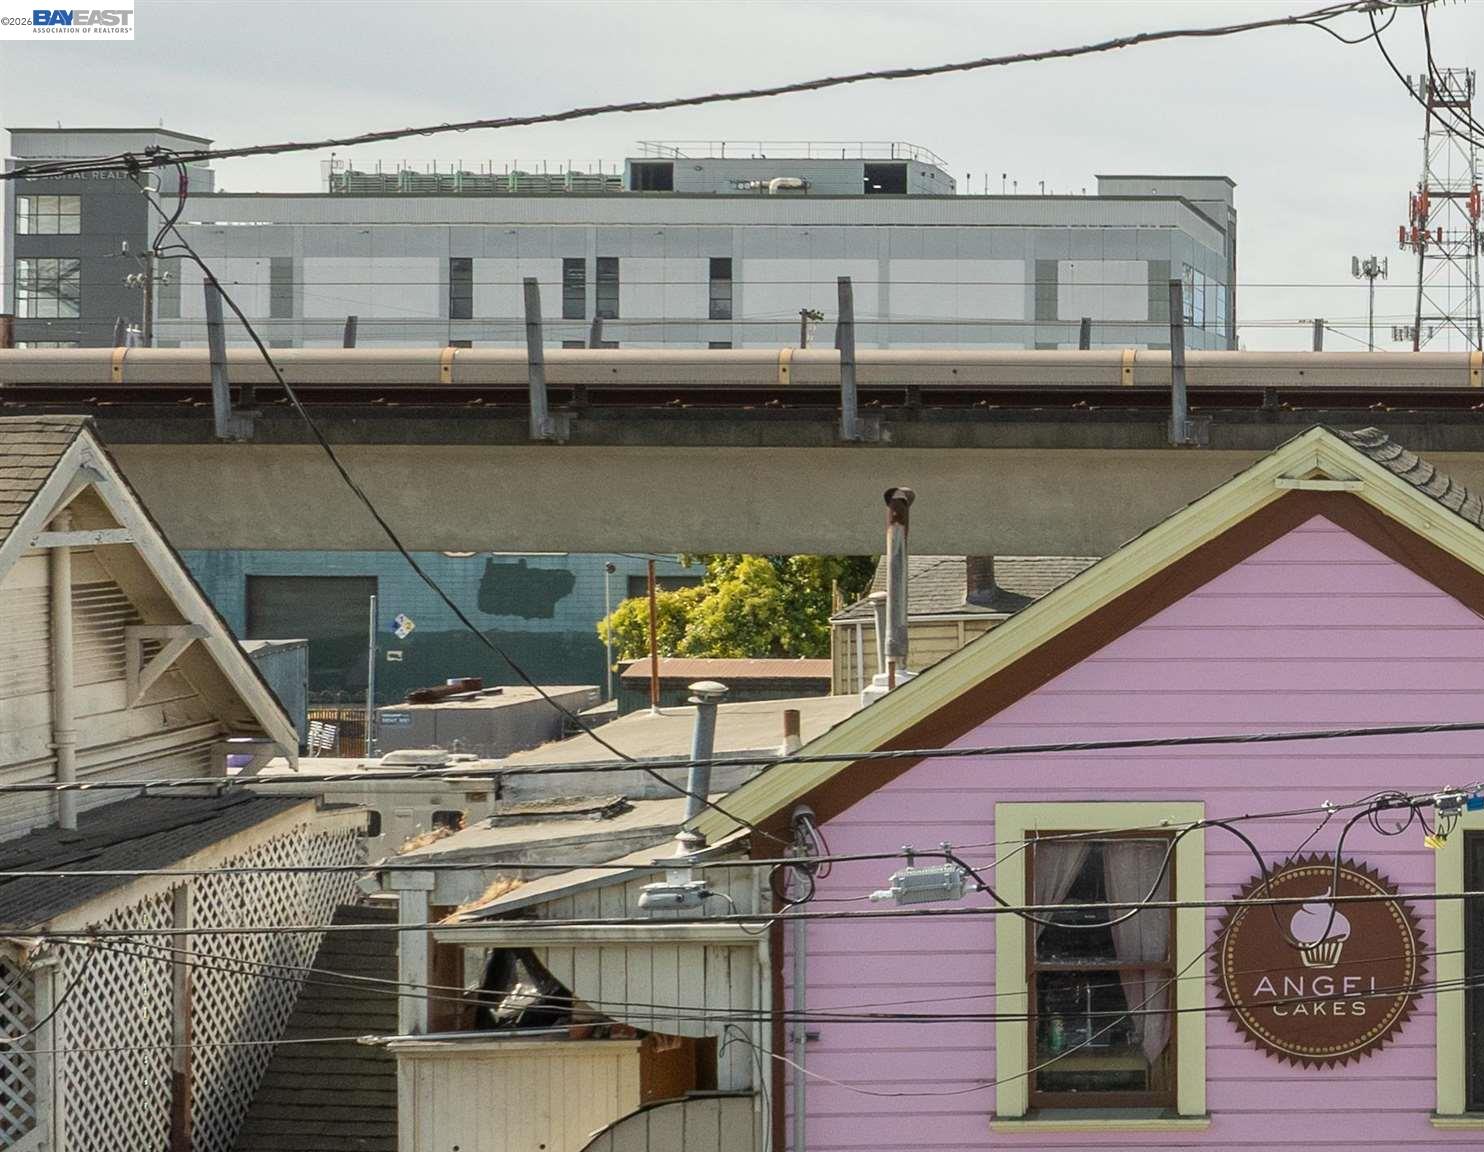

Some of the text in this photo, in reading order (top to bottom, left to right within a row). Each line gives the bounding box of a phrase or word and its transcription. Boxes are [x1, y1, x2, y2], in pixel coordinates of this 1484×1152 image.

[41, 171, 128, 180] GITAL REALT
[1272, 1001, 1367, 1017] CAKES
